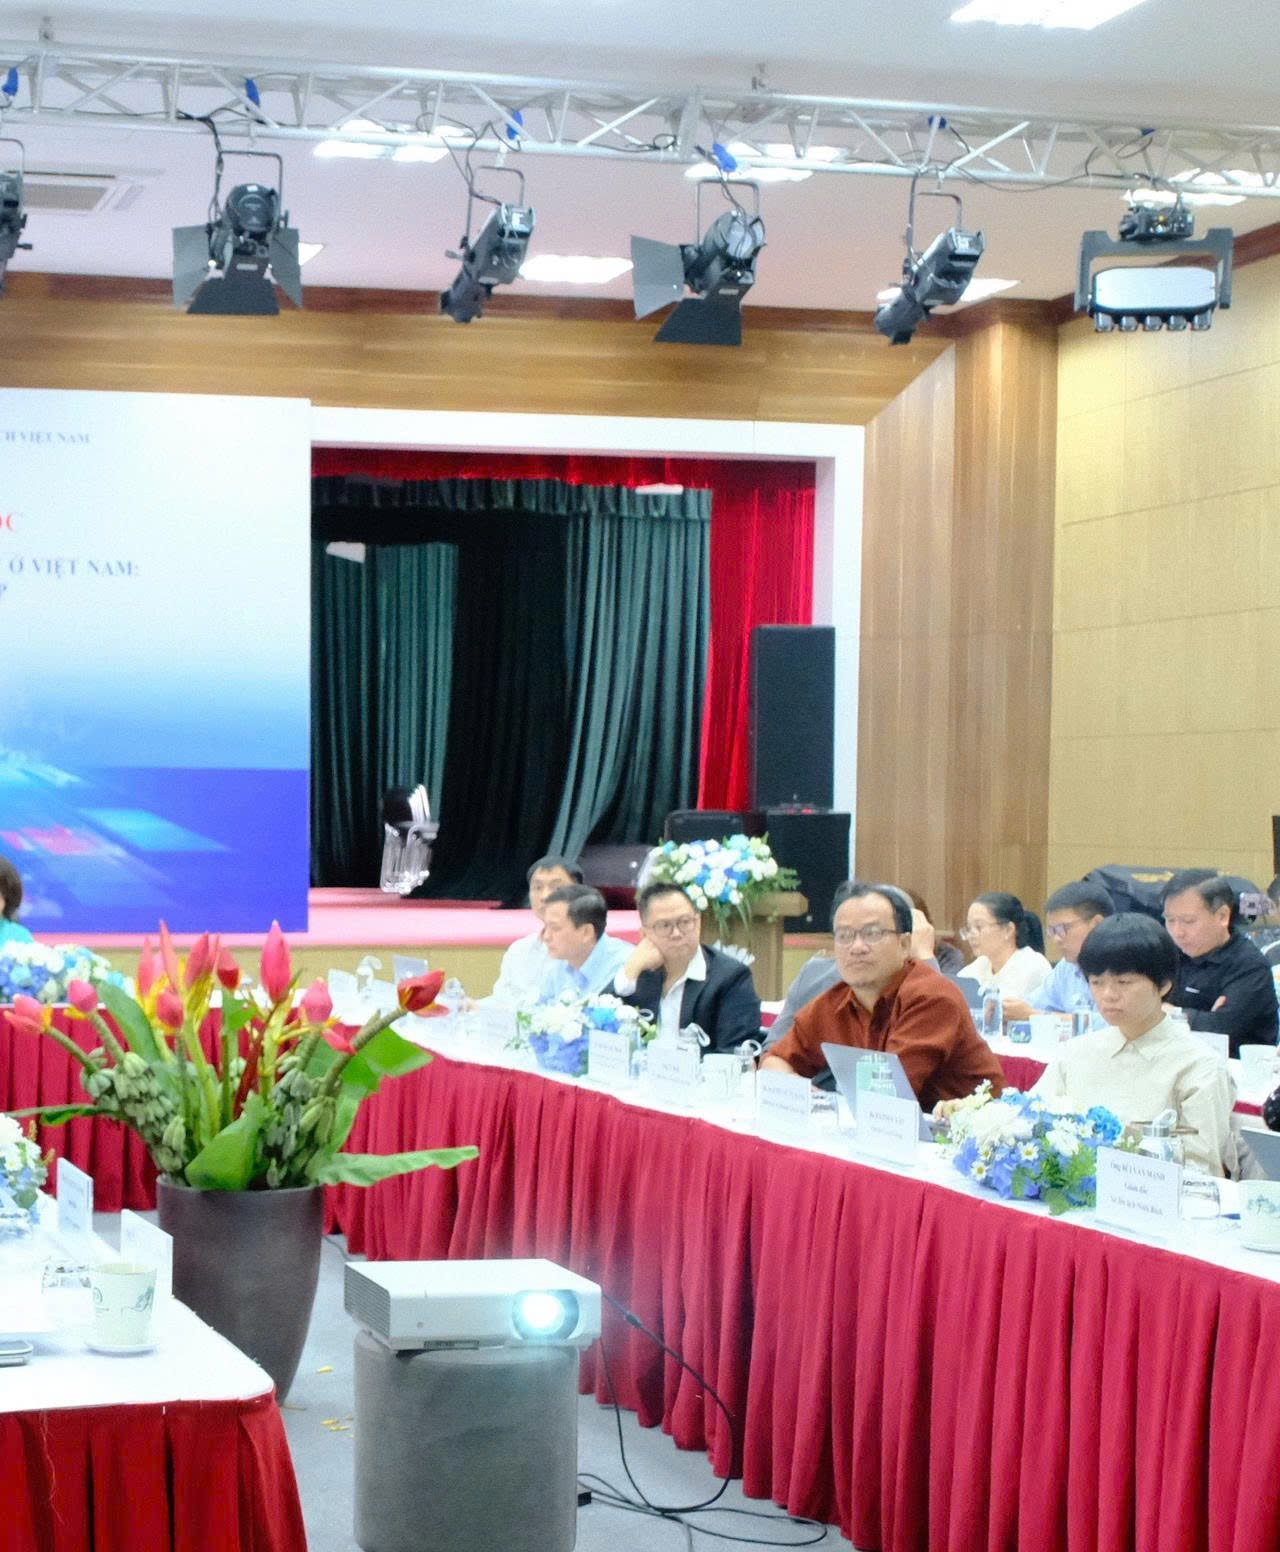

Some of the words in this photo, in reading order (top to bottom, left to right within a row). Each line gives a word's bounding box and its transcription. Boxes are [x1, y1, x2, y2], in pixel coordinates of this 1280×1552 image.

[57, 432, 90, 445] NAM
[31, 556, 79, 580] VIỆT
[88, 559, 140, 576] NAM:
